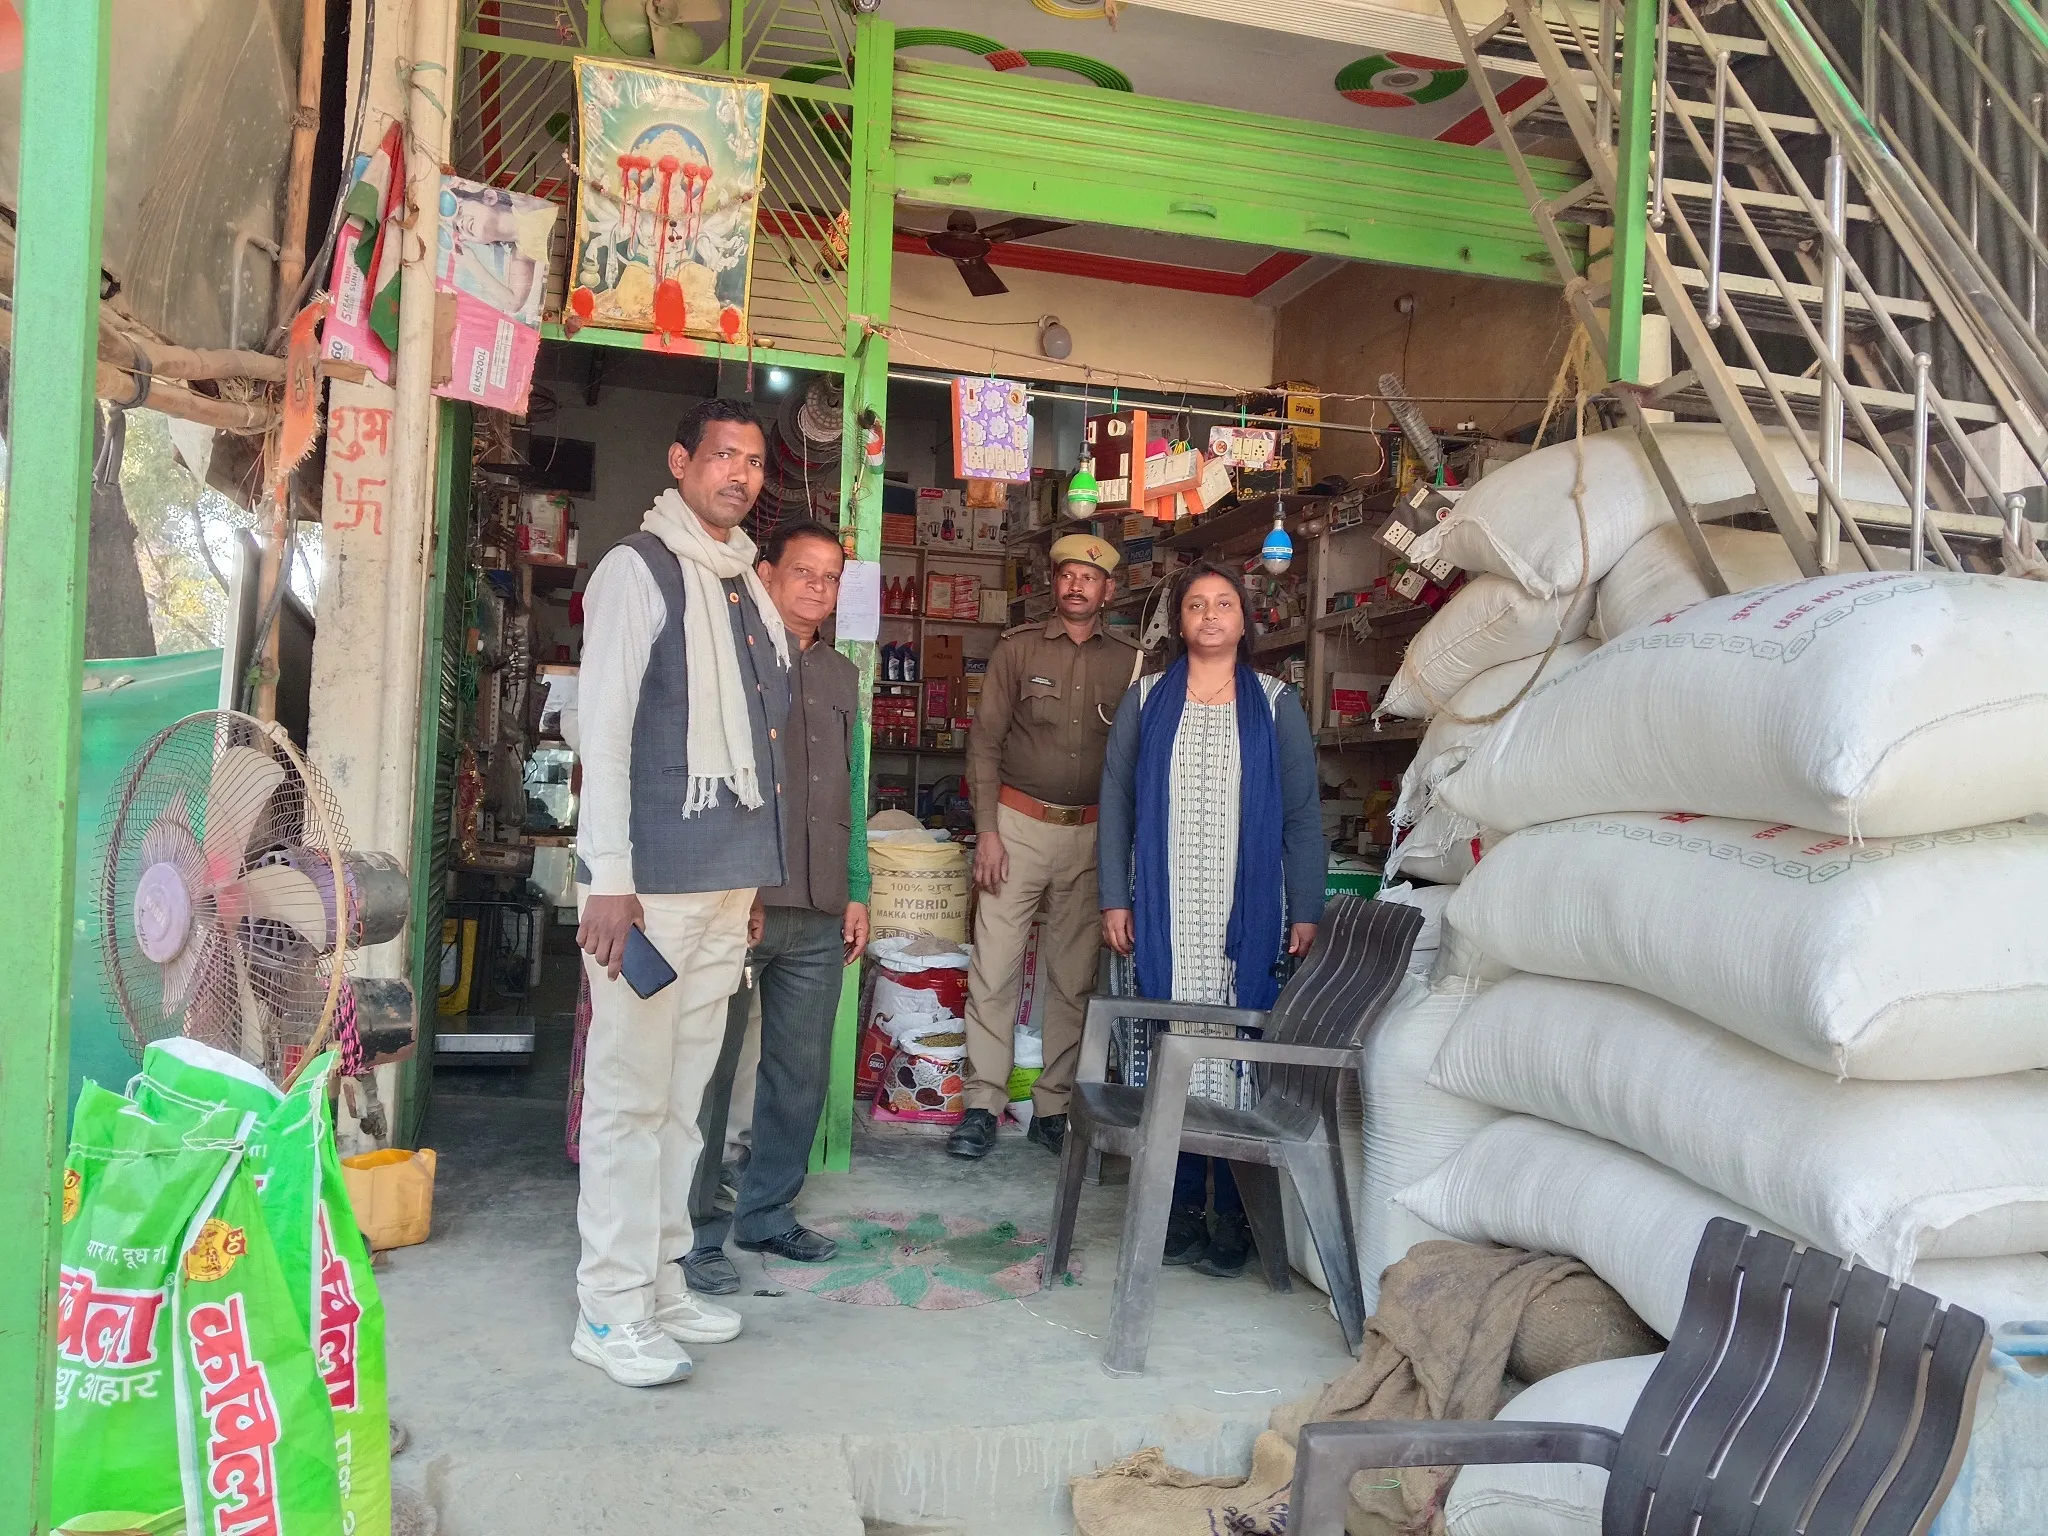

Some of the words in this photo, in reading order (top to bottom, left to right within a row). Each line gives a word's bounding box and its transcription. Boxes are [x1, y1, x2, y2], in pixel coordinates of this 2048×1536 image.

[1294, 403, 1315, 415] DYNEX
[330, 405, 393, 463] शुभ
[1773, 604, 1816, 630] USE
[1801, 838, 1850, 856] USE
[891, 883, 923, 893] 100%
[894, 898, 949, 910] HYBRID
[876, 909, 907, 920] MAKKA
[909, 912, 940, 921] CHUNI
[226, 1231, 243, 1254] 30
[121, 1248, 150, 1269] दूध
[78, 1370, 162, 1407] आहार
